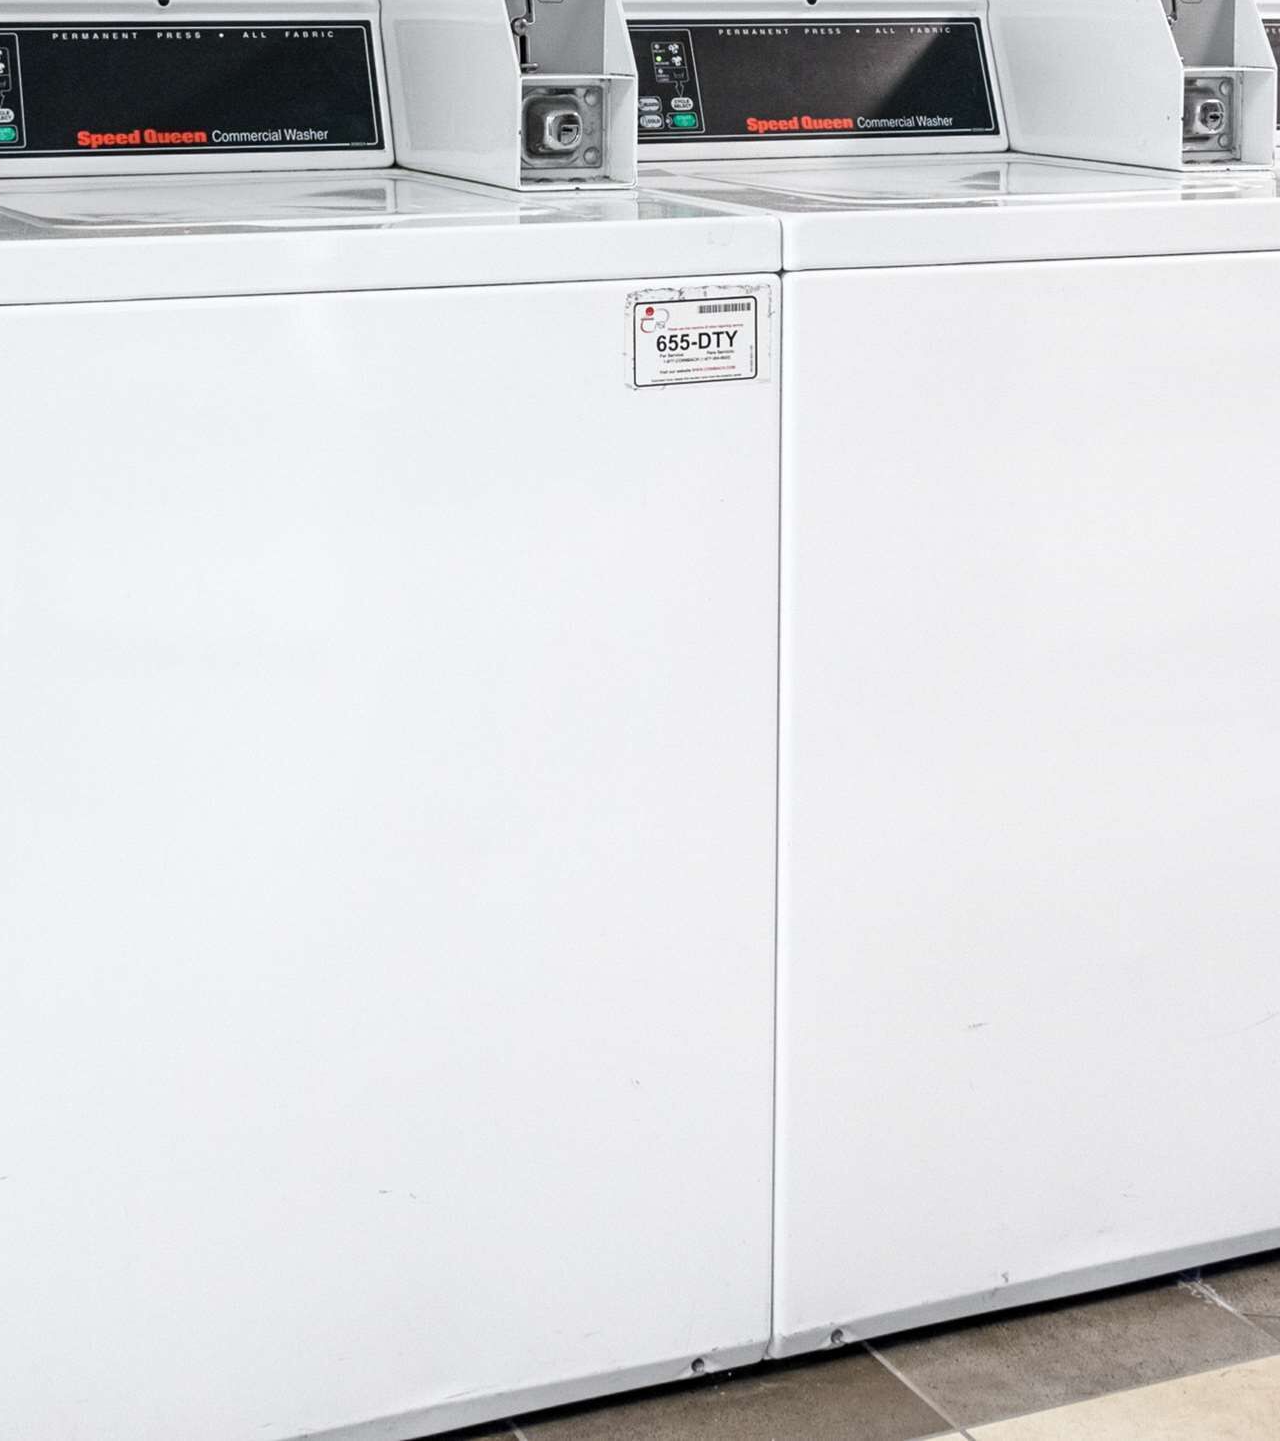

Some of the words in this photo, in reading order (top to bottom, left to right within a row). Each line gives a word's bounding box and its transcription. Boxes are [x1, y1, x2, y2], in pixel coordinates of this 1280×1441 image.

[52, 32, 138, 40] PERMANENT
[718, 28, 790, 37] PERMANENT
[910, 26, 951, 34] FABRIC
[746, 116, 799, 134] Speed
[802, 115, 853, 130] Queen
[857, 116, 915, 129] Commercial
[916, 115, 953, 127] Washer
[77, 129, 140, 149] Speed
[144, 128, 207, 144] Queen
[212, 129, 282, 144] Commercial
[284, 128, 328, 141] Washer
[656, 330, 738, 352] 655-DTY
